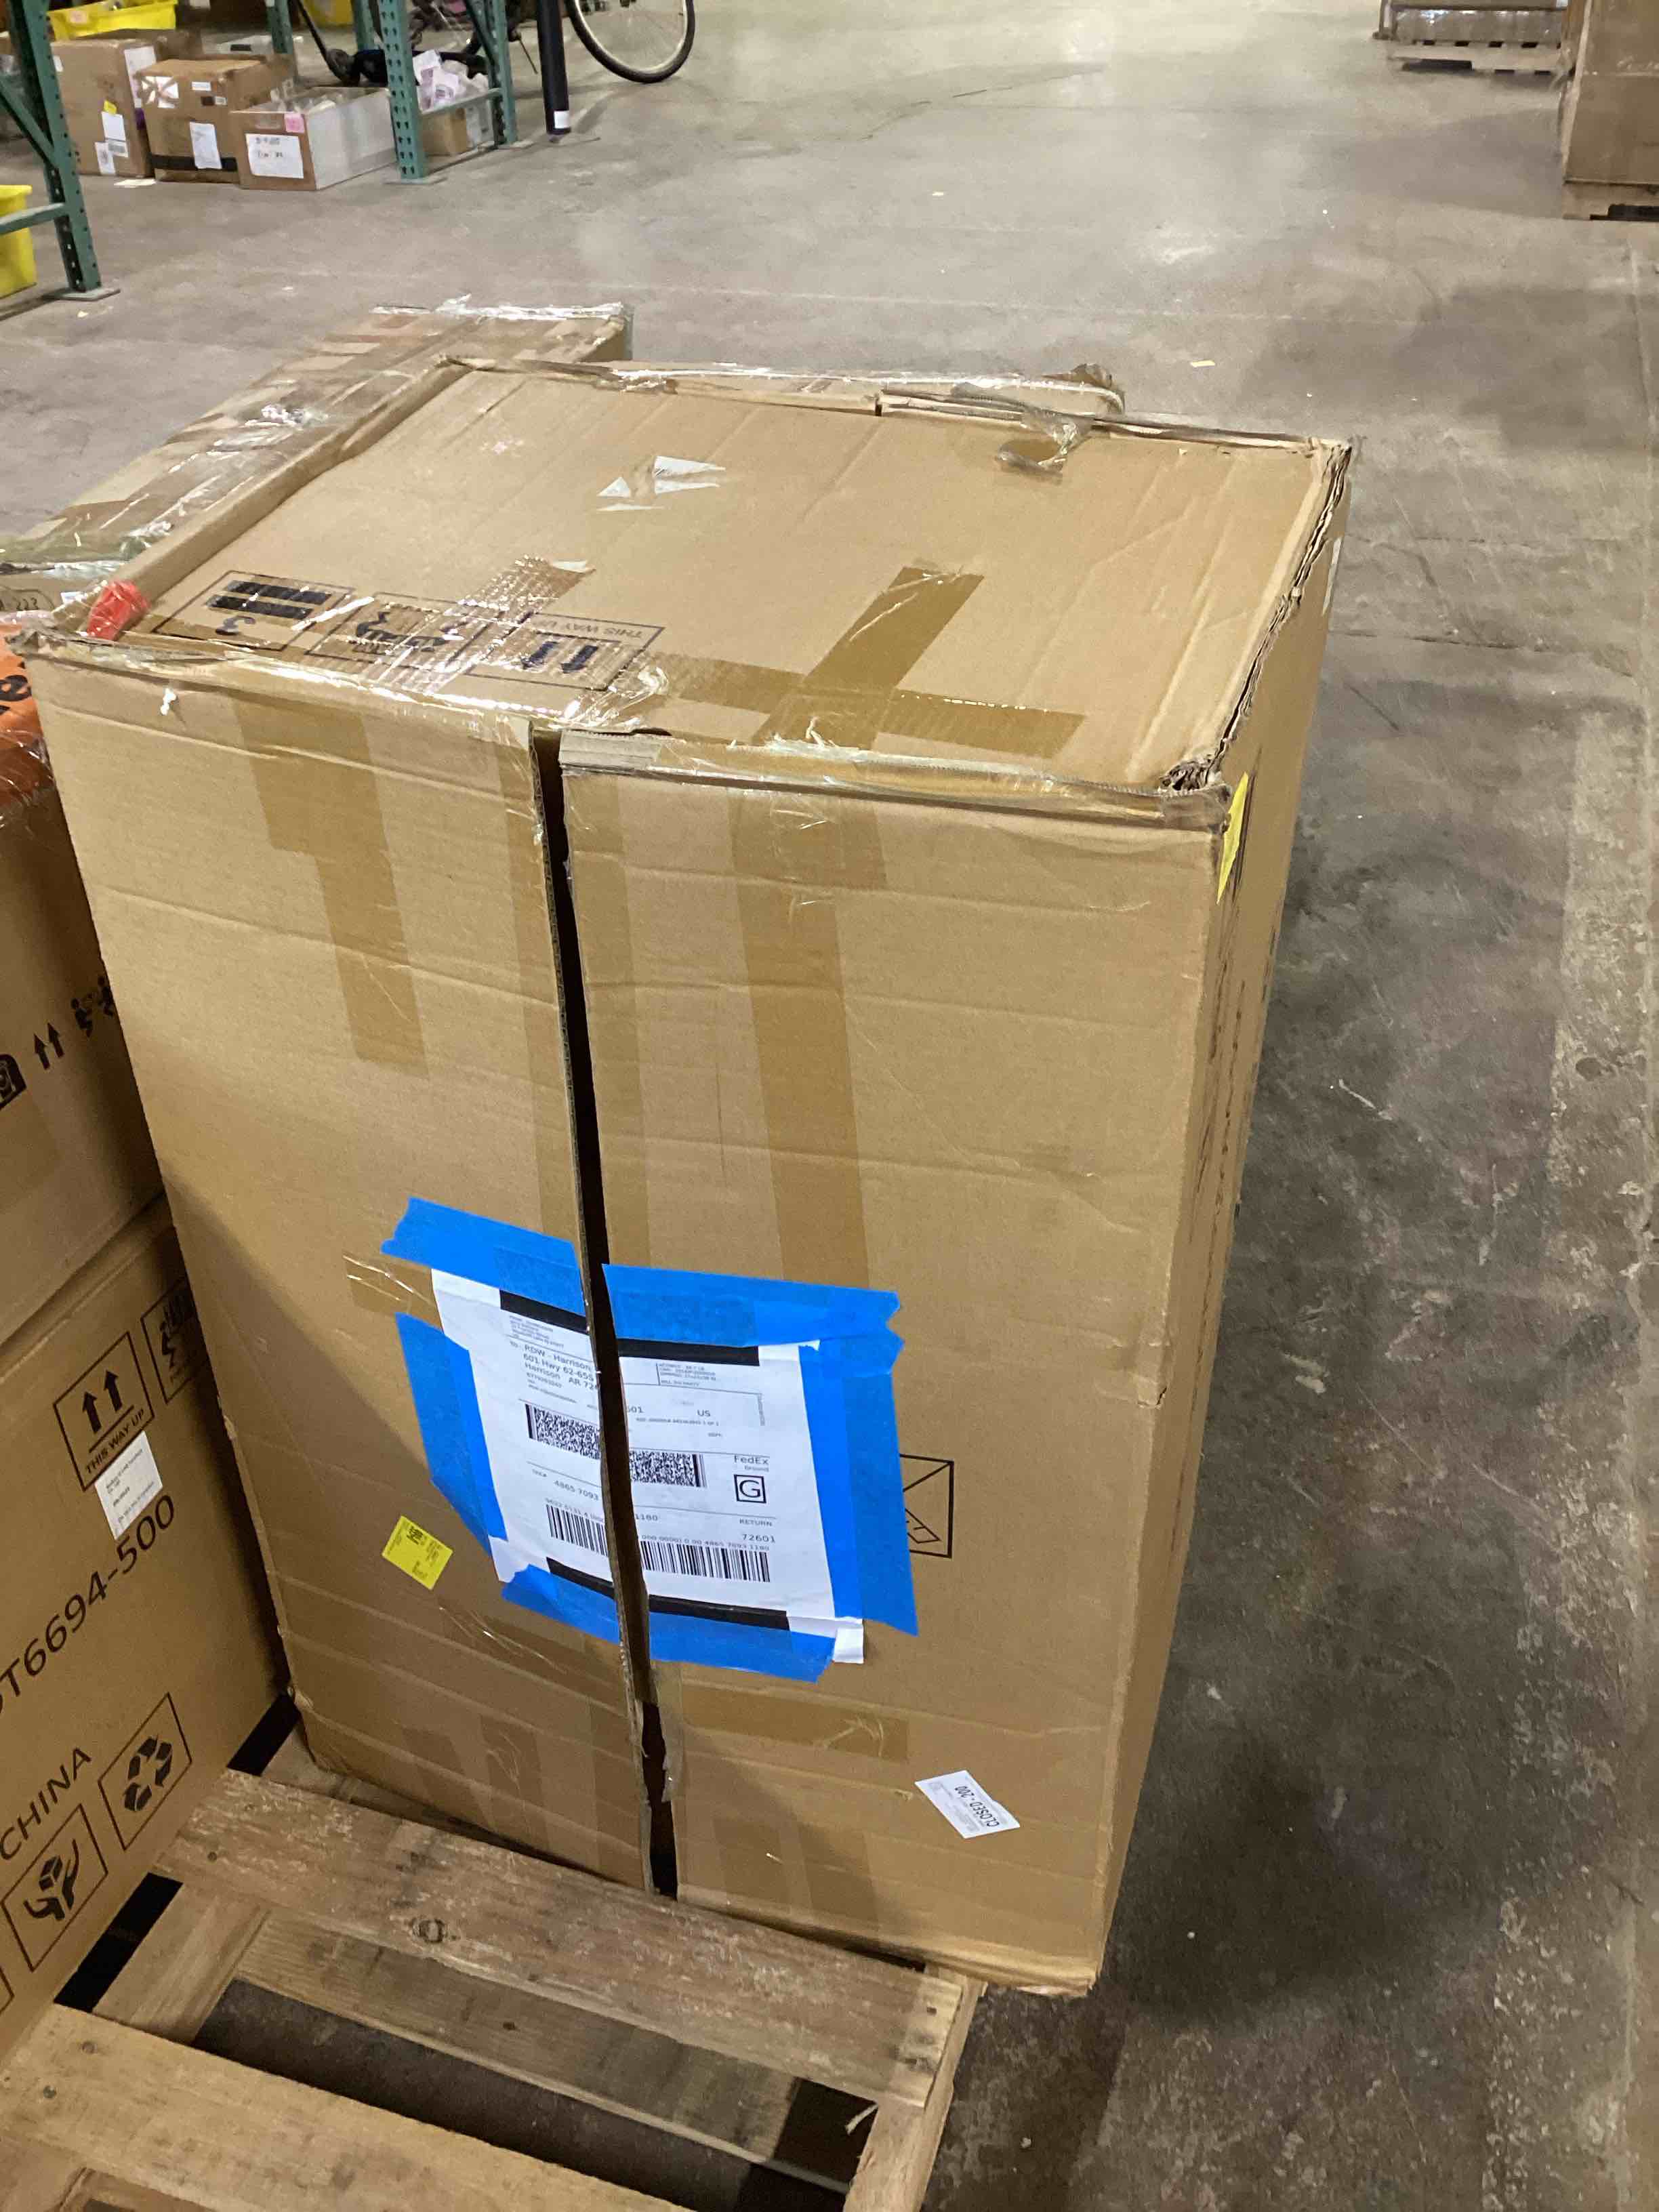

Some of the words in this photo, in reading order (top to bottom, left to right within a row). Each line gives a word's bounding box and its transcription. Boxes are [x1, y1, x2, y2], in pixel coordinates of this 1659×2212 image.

[541, 1358, 560, 1372] Hwy
[697, 1409, 711, 1417] US
[85, 1448, 108, 1473] THIS
[108, 1424, 129, 1449] WAY
[131, 1408, 144, 1427] UP
[733, 1455, 769, 1465] FedEx
[739, 1479, 761, 1498] G
[739, 1518, 773, 1527] RETURN
[741, 1533, 776, 1543] 72601
[0, 1495, 174, 1713] T6694-500
[0, 1748, 91, 1860] CHINA
[970, 1801, 1000, 1827] CLOSED
